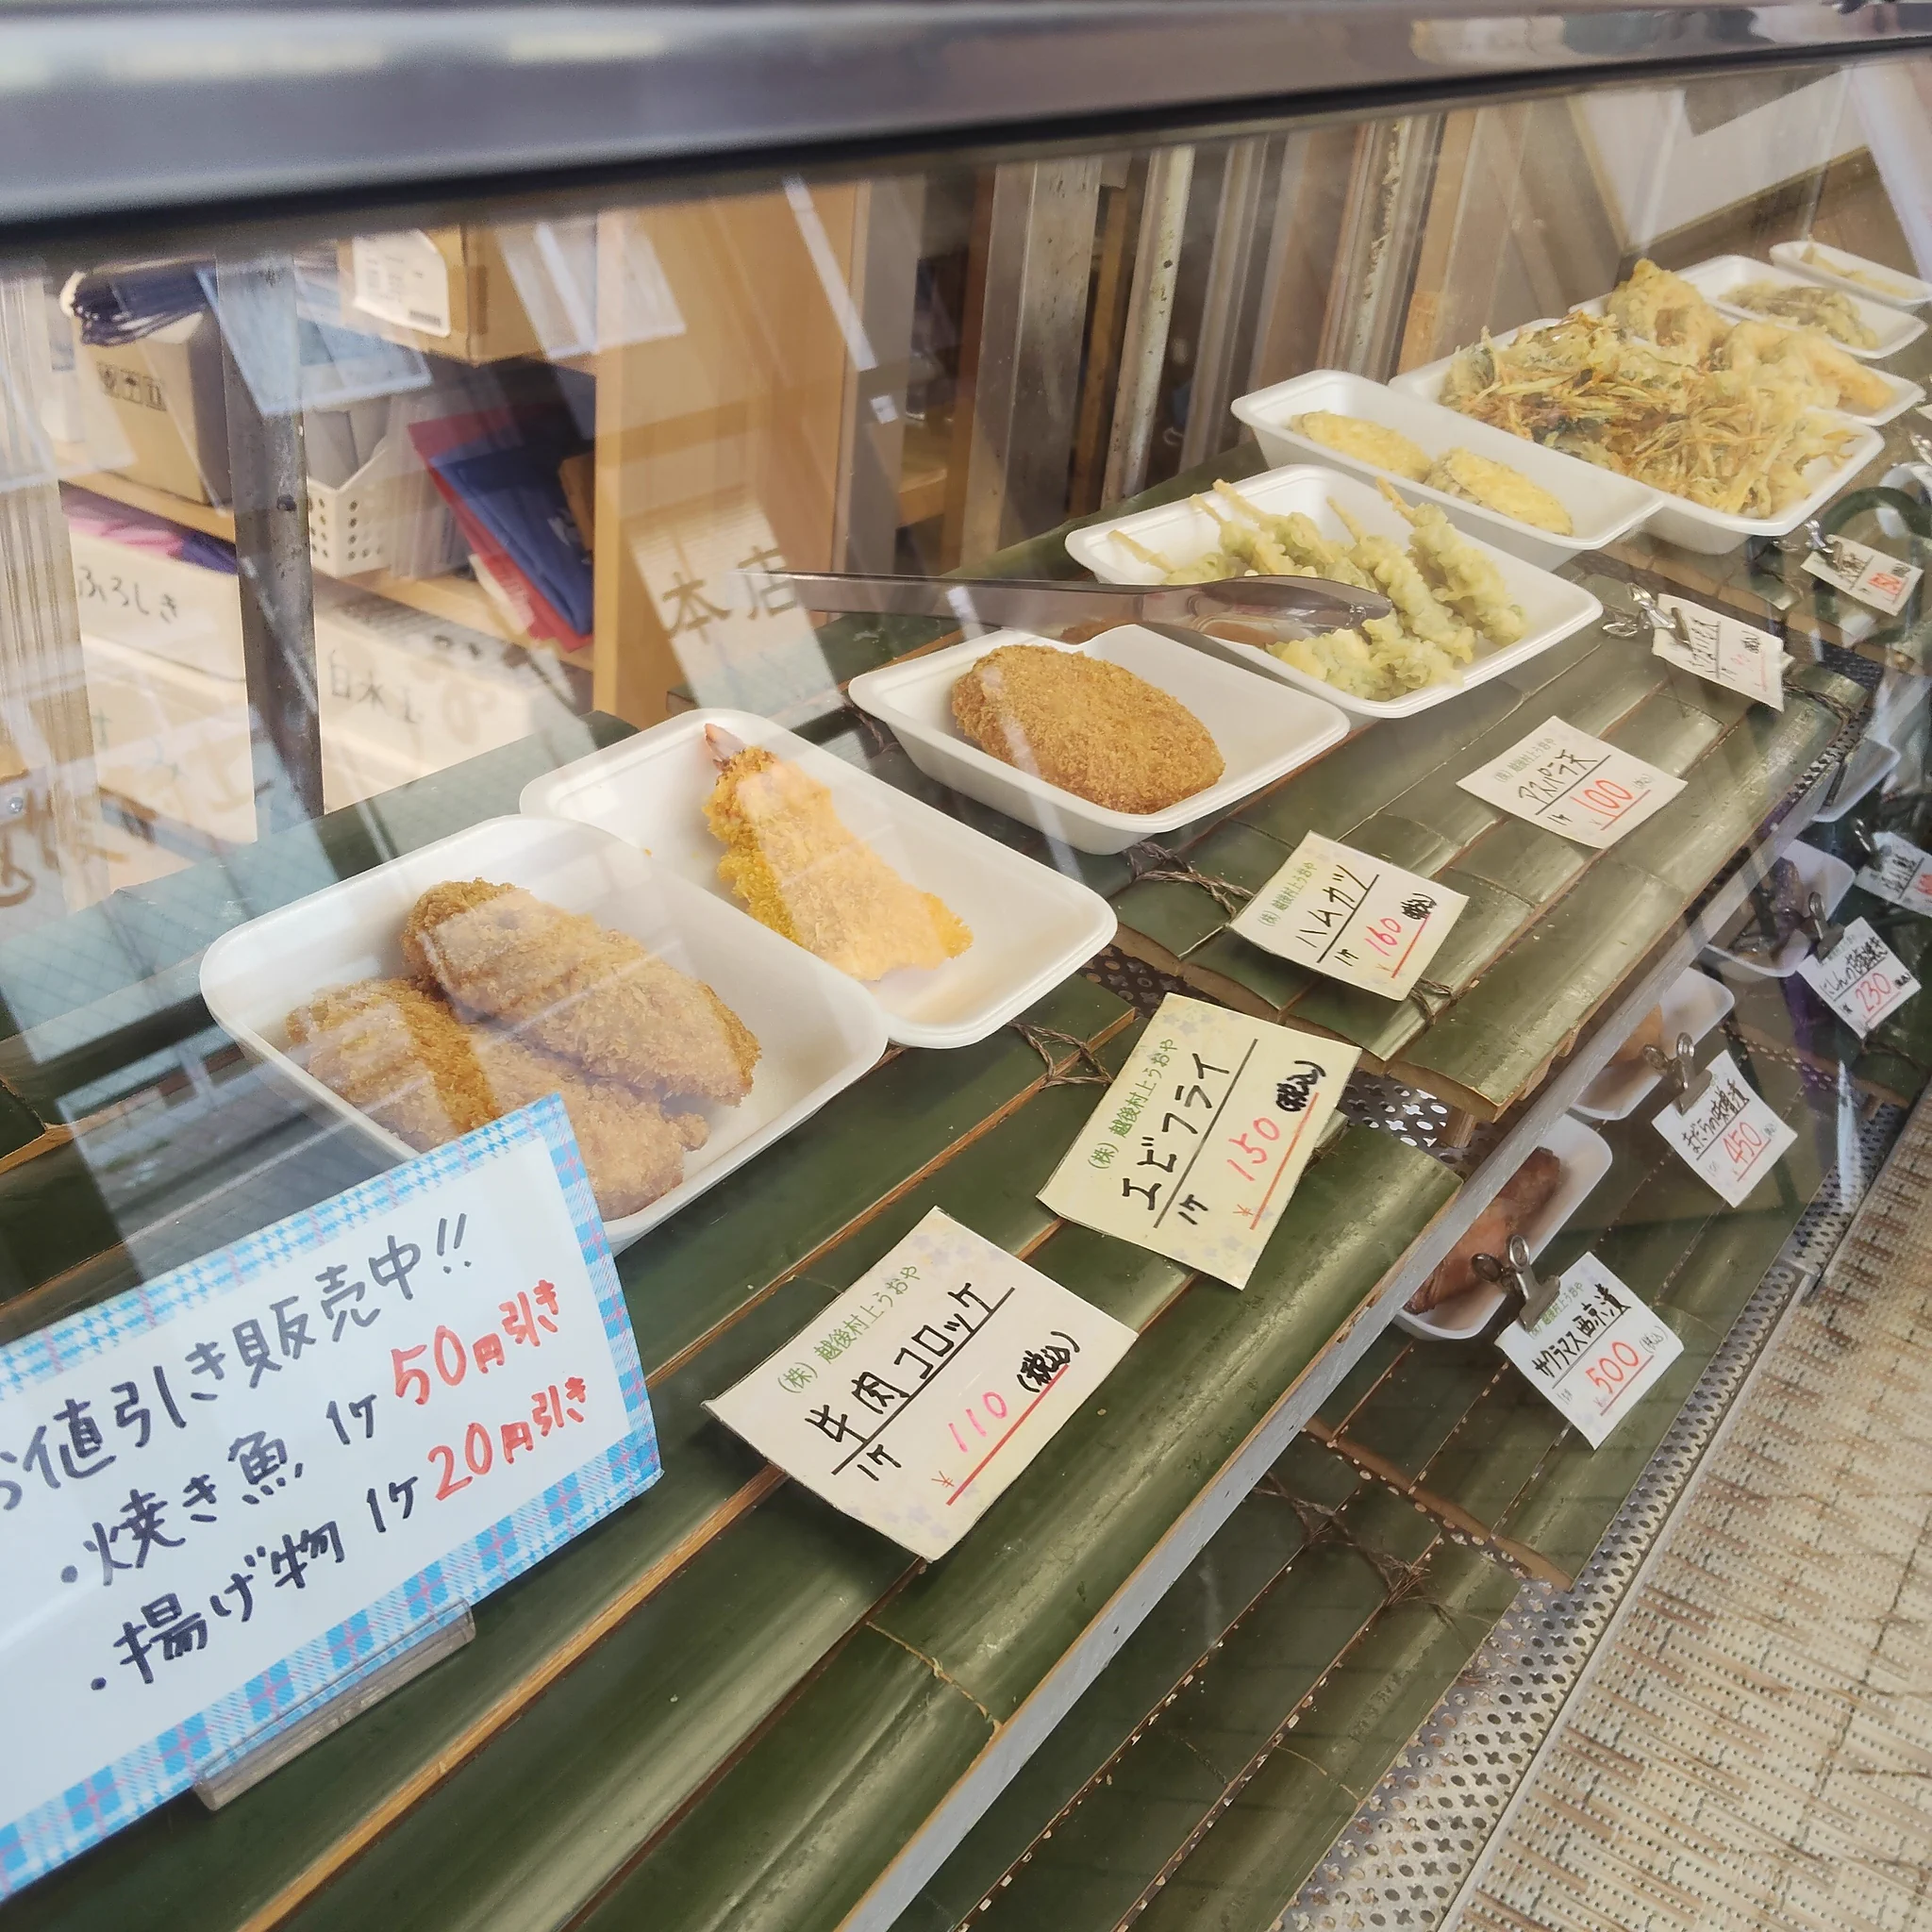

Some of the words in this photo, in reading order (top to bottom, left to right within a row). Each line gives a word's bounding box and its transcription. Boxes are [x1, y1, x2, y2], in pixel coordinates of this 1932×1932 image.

[1519, 749, 1598, 804] アスパラ天
[1570, 779, 1633, 818] 100
[1295, 864, 1369, 949] ハムカツ
[1364, 918, 1402, 958] 160
[1855, 973, 1891, 1012] 230
[1122, 1052, 1230, 1211] エビフライ
[1226, 1117, 1281, 1181] 150
[1722, 1121, 1763, 1165] 450
[391, 1279, 560, 1405] 50円引き
[814, 1265, 922, 1365] 越後村上うおや
[804, 1282, 994, 1444] 牛肉コロッケ
[1585, 1341, 1640, 1395] 500
[427, 1376, 588, 1501] 20円引き
[947, 1391, 1008, 1454] 110
